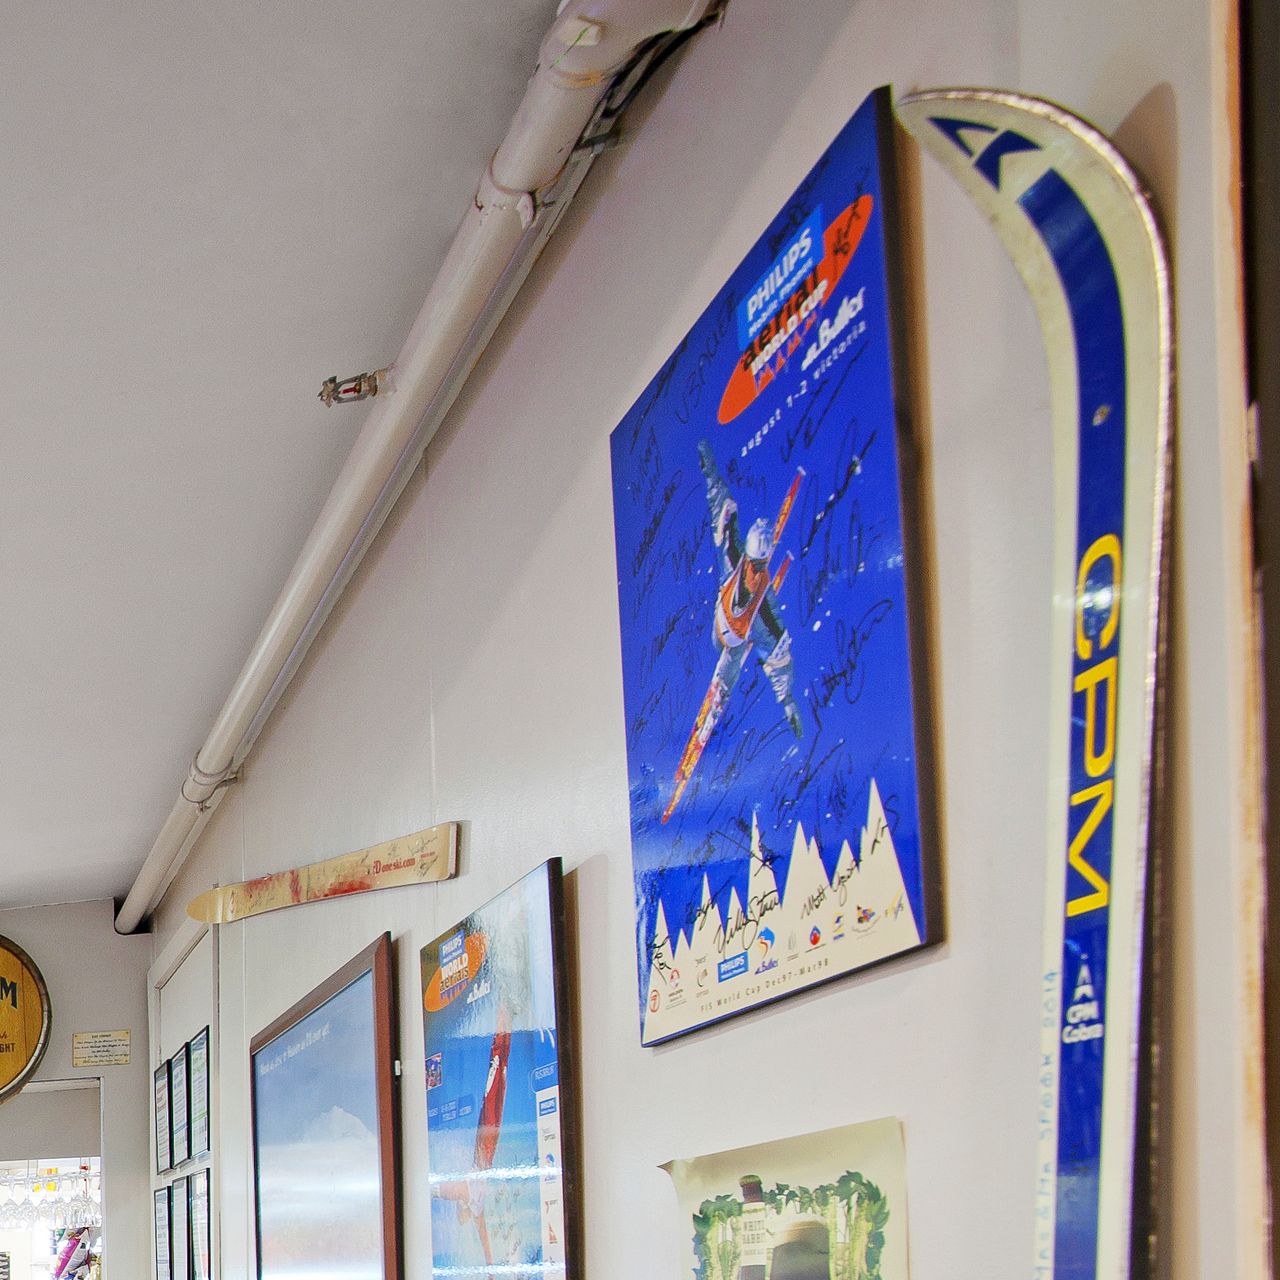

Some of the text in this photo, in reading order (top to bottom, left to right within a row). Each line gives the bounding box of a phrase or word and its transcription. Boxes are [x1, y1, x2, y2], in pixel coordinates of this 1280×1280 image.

[747, 228, 811, 321] PHILIPS
[741, 408, 782, 457] august
[813, 320, 867, 380] victoria
[1066, 532, 1123, 917] CPM
[441, 953, 468, 981] WORLD
[442, 934, 463, 956] PHILIPS
